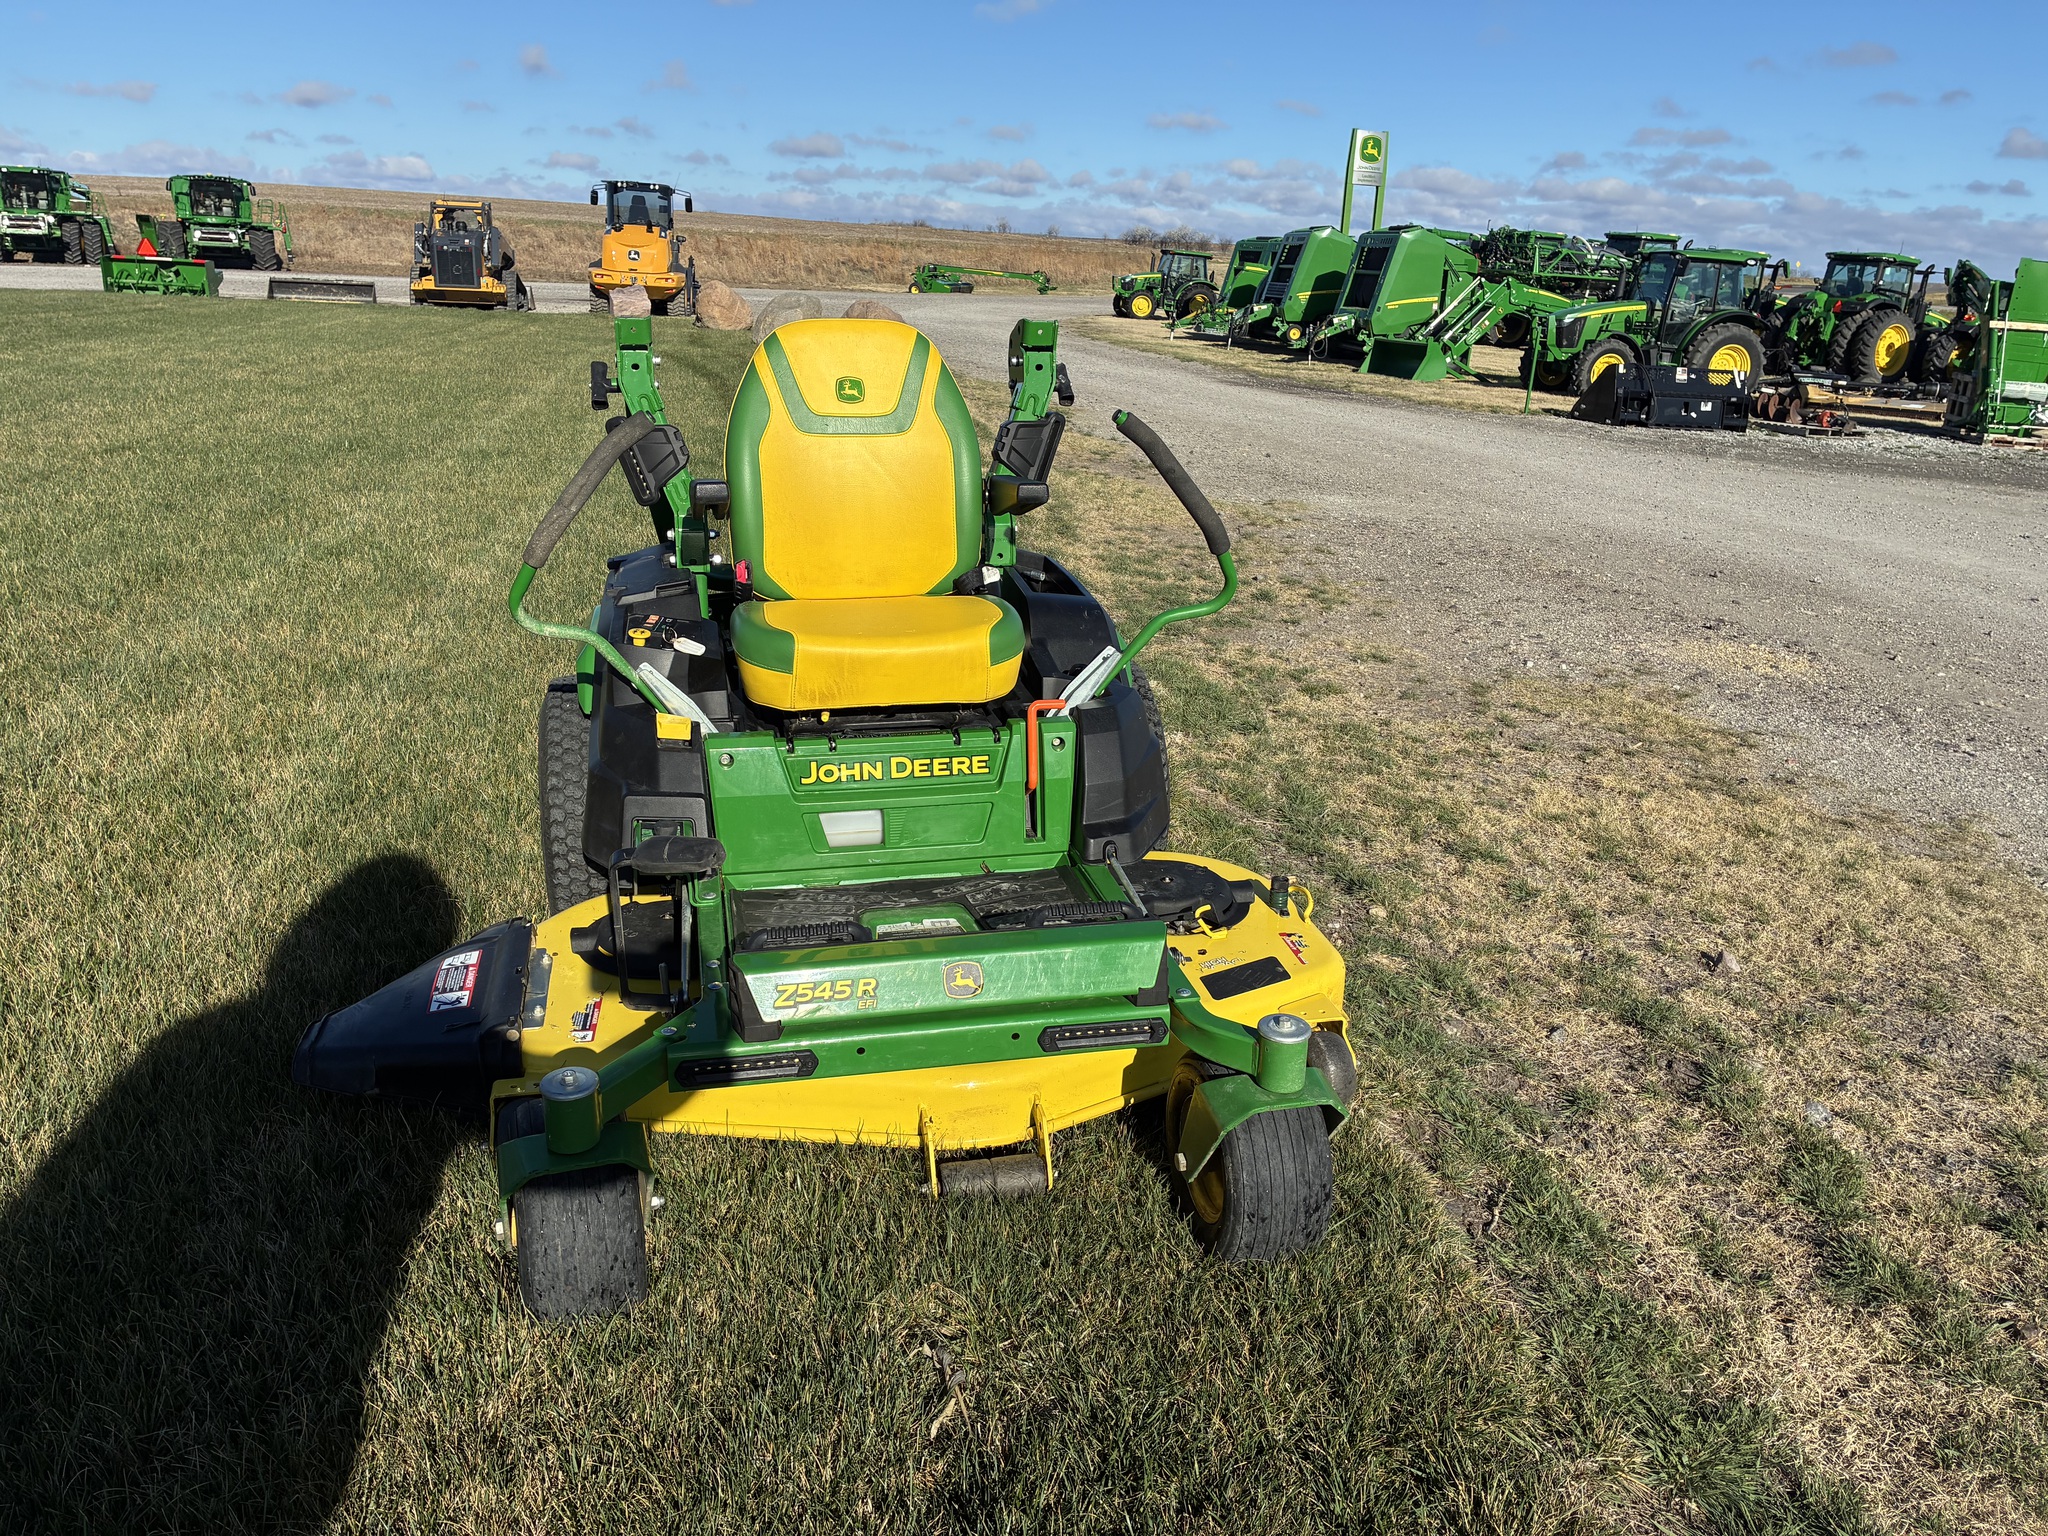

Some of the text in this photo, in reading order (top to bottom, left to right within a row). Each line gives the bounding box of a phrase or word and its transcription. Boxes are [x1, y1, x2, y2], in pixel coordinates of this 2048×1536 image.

[800, 755, 990, 785] JOHN DEERE
[773, 976, 879, 1010] Z545 R
[856, 998, 878, 1010] EFI
